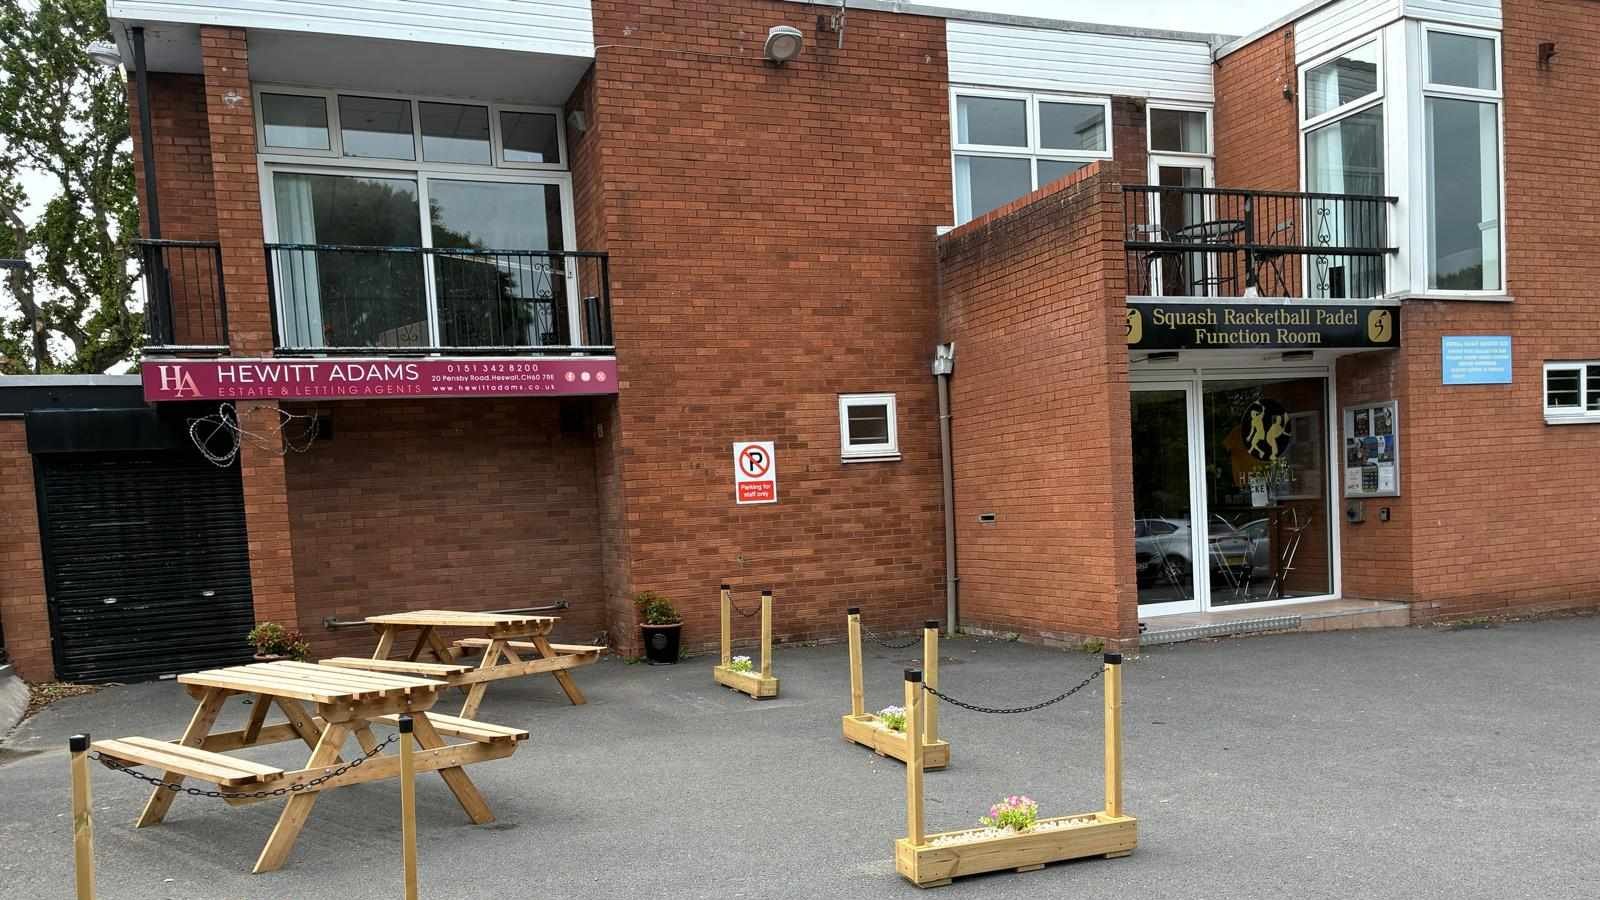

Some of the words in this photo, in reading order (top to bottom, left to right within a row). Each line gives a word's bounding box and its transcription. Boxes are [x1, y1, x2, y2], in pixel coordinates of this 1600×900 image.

[1152, 308, 1217, 329] Squash
[1223, 308, 1310, 325] Racketball
[1316, 308, 1358, 325] Padel
[1194, 328, 1270, 344] Function
[1276, 328, 1321, 344] Room
[217, 364, 319, 383] HEWITT
[329, 363, 419, 381] ADAMS
[447, 364, 477, 372] 0151
[482, 364, 504, 372] 342
[509, 364, 539, 372] 8200
[218, 386, 274, 397] ESTATE
[280, 386, 289, 396] &
[295, 385, 358, 396] LETTING
[364, 384, 422, 395] AGENTS
